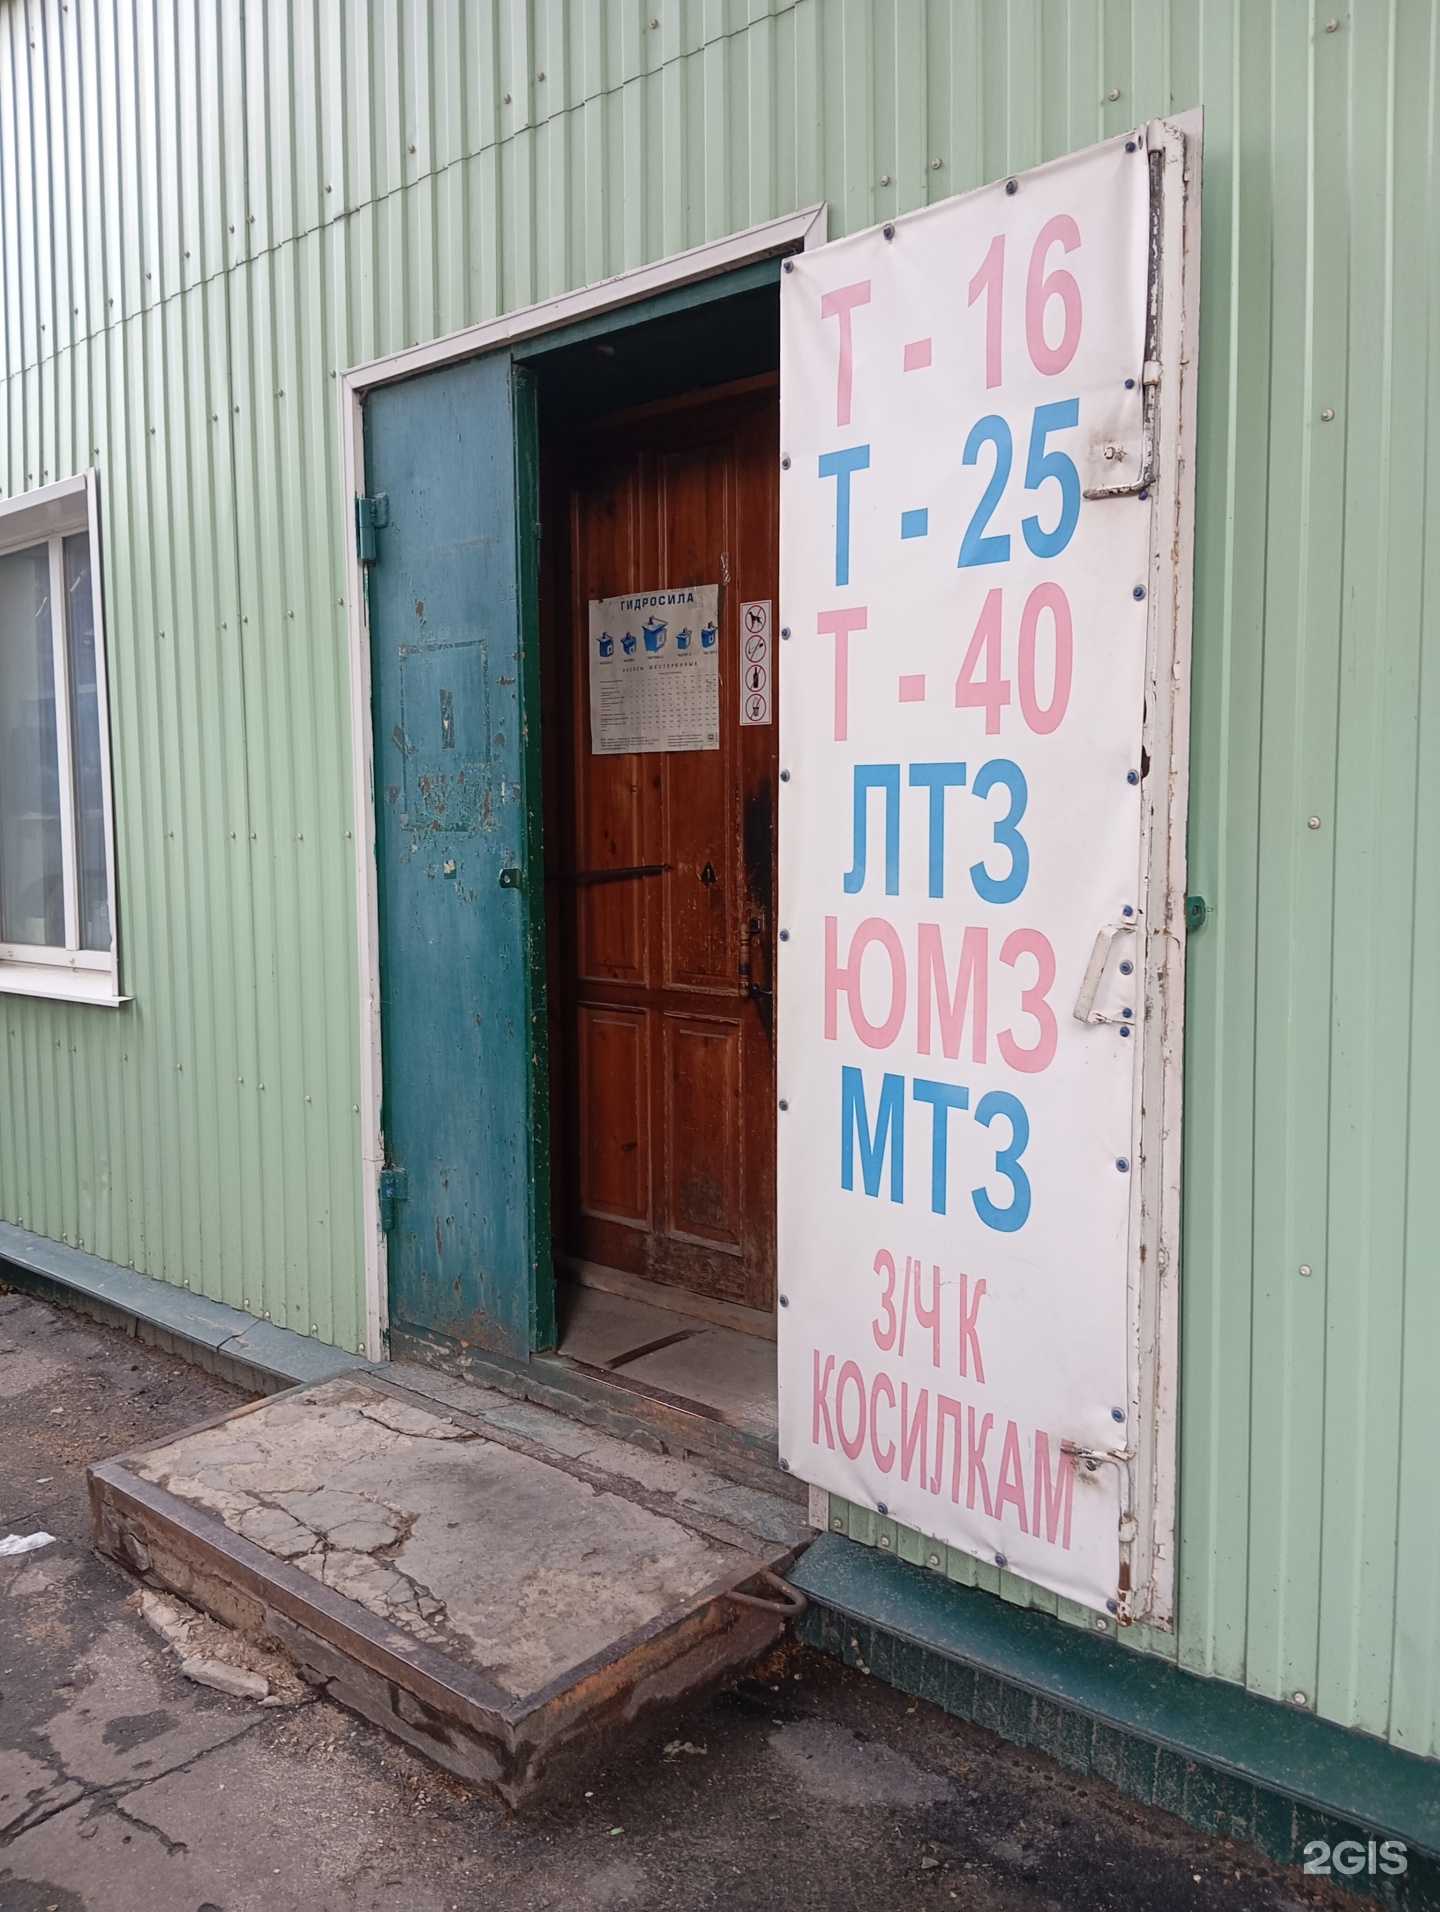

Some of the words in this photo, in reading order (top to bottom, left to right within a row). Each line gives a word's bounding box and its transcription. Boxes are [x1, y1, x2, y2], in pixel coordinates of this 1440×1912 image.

[821, 280, 872, 427] Т
[967, 213, 1083, 390] 16
[818, 444, 870, 587] Т
[957, 397, 1081, 568] 25
[620, 592, 694, 611] ГИДРОСИЛА
[817, 606, 868, 742] Т
[954, 582, 1074, 736] 40
[843, 758, 1030, 904] ЛТЗ
[824, 915, 1058, 1074] ЮМЗ
[841, 1065, 1031, 1233] МТЗ
[872, 1249, 941, 1368] З/Ч
[959, 1273, 987, 1384] К
[812, 1349, 1077, 1551] КОСИЛКАМ
